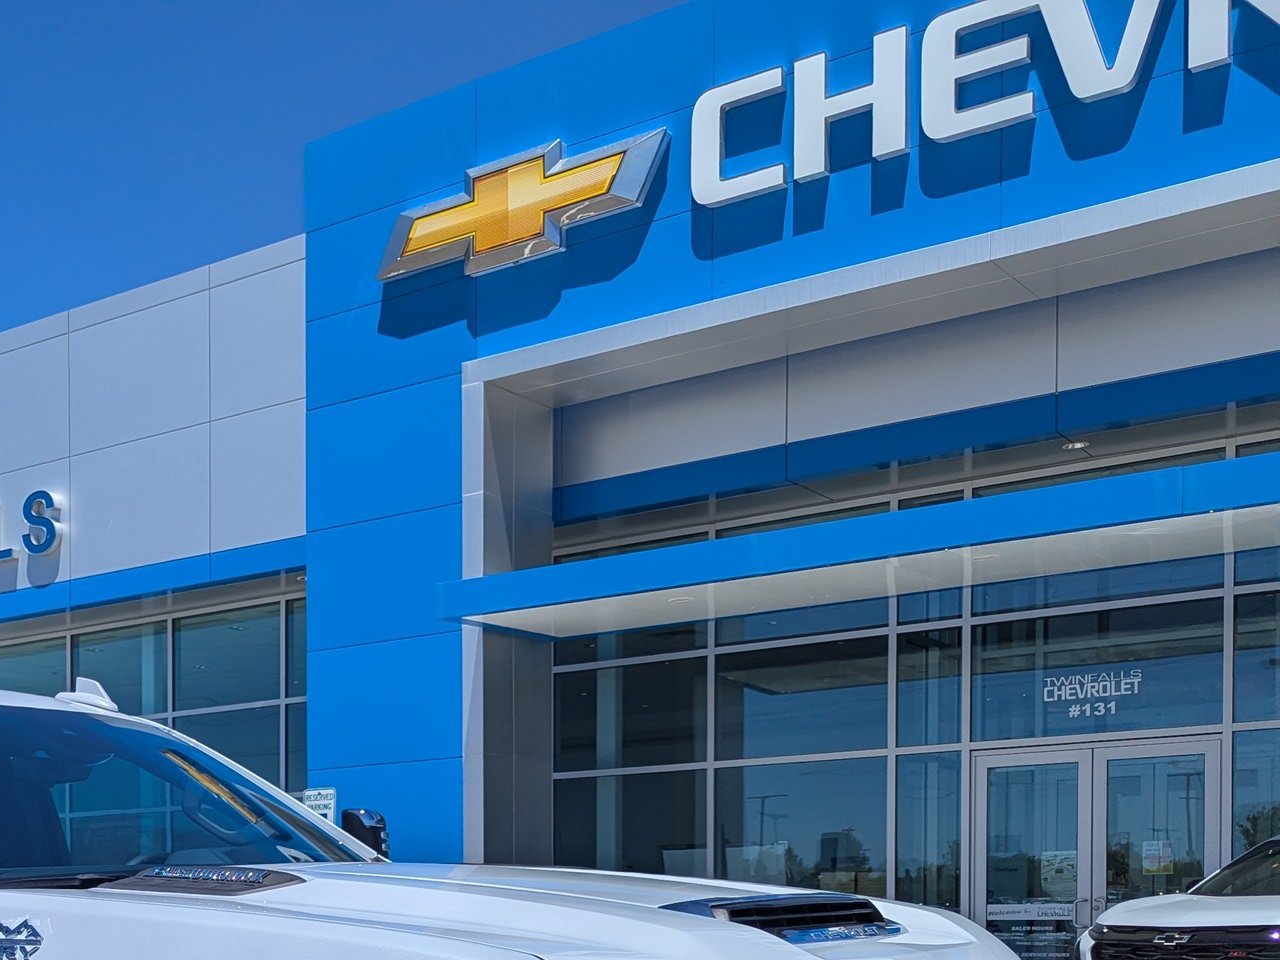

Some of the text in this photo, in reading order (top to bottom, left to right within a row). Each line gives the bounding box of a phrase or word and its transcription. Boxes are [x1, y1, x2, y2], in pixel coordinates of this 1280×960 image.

[1043, 679, 1142, 702] CHEVROLET
[1068, 701, 1117, 718] #131
[305, 793, 334, 801] RESERVED
[306, 802, 332, 811] PARKING
[810, 926, 879, 939] CHEVROLET
